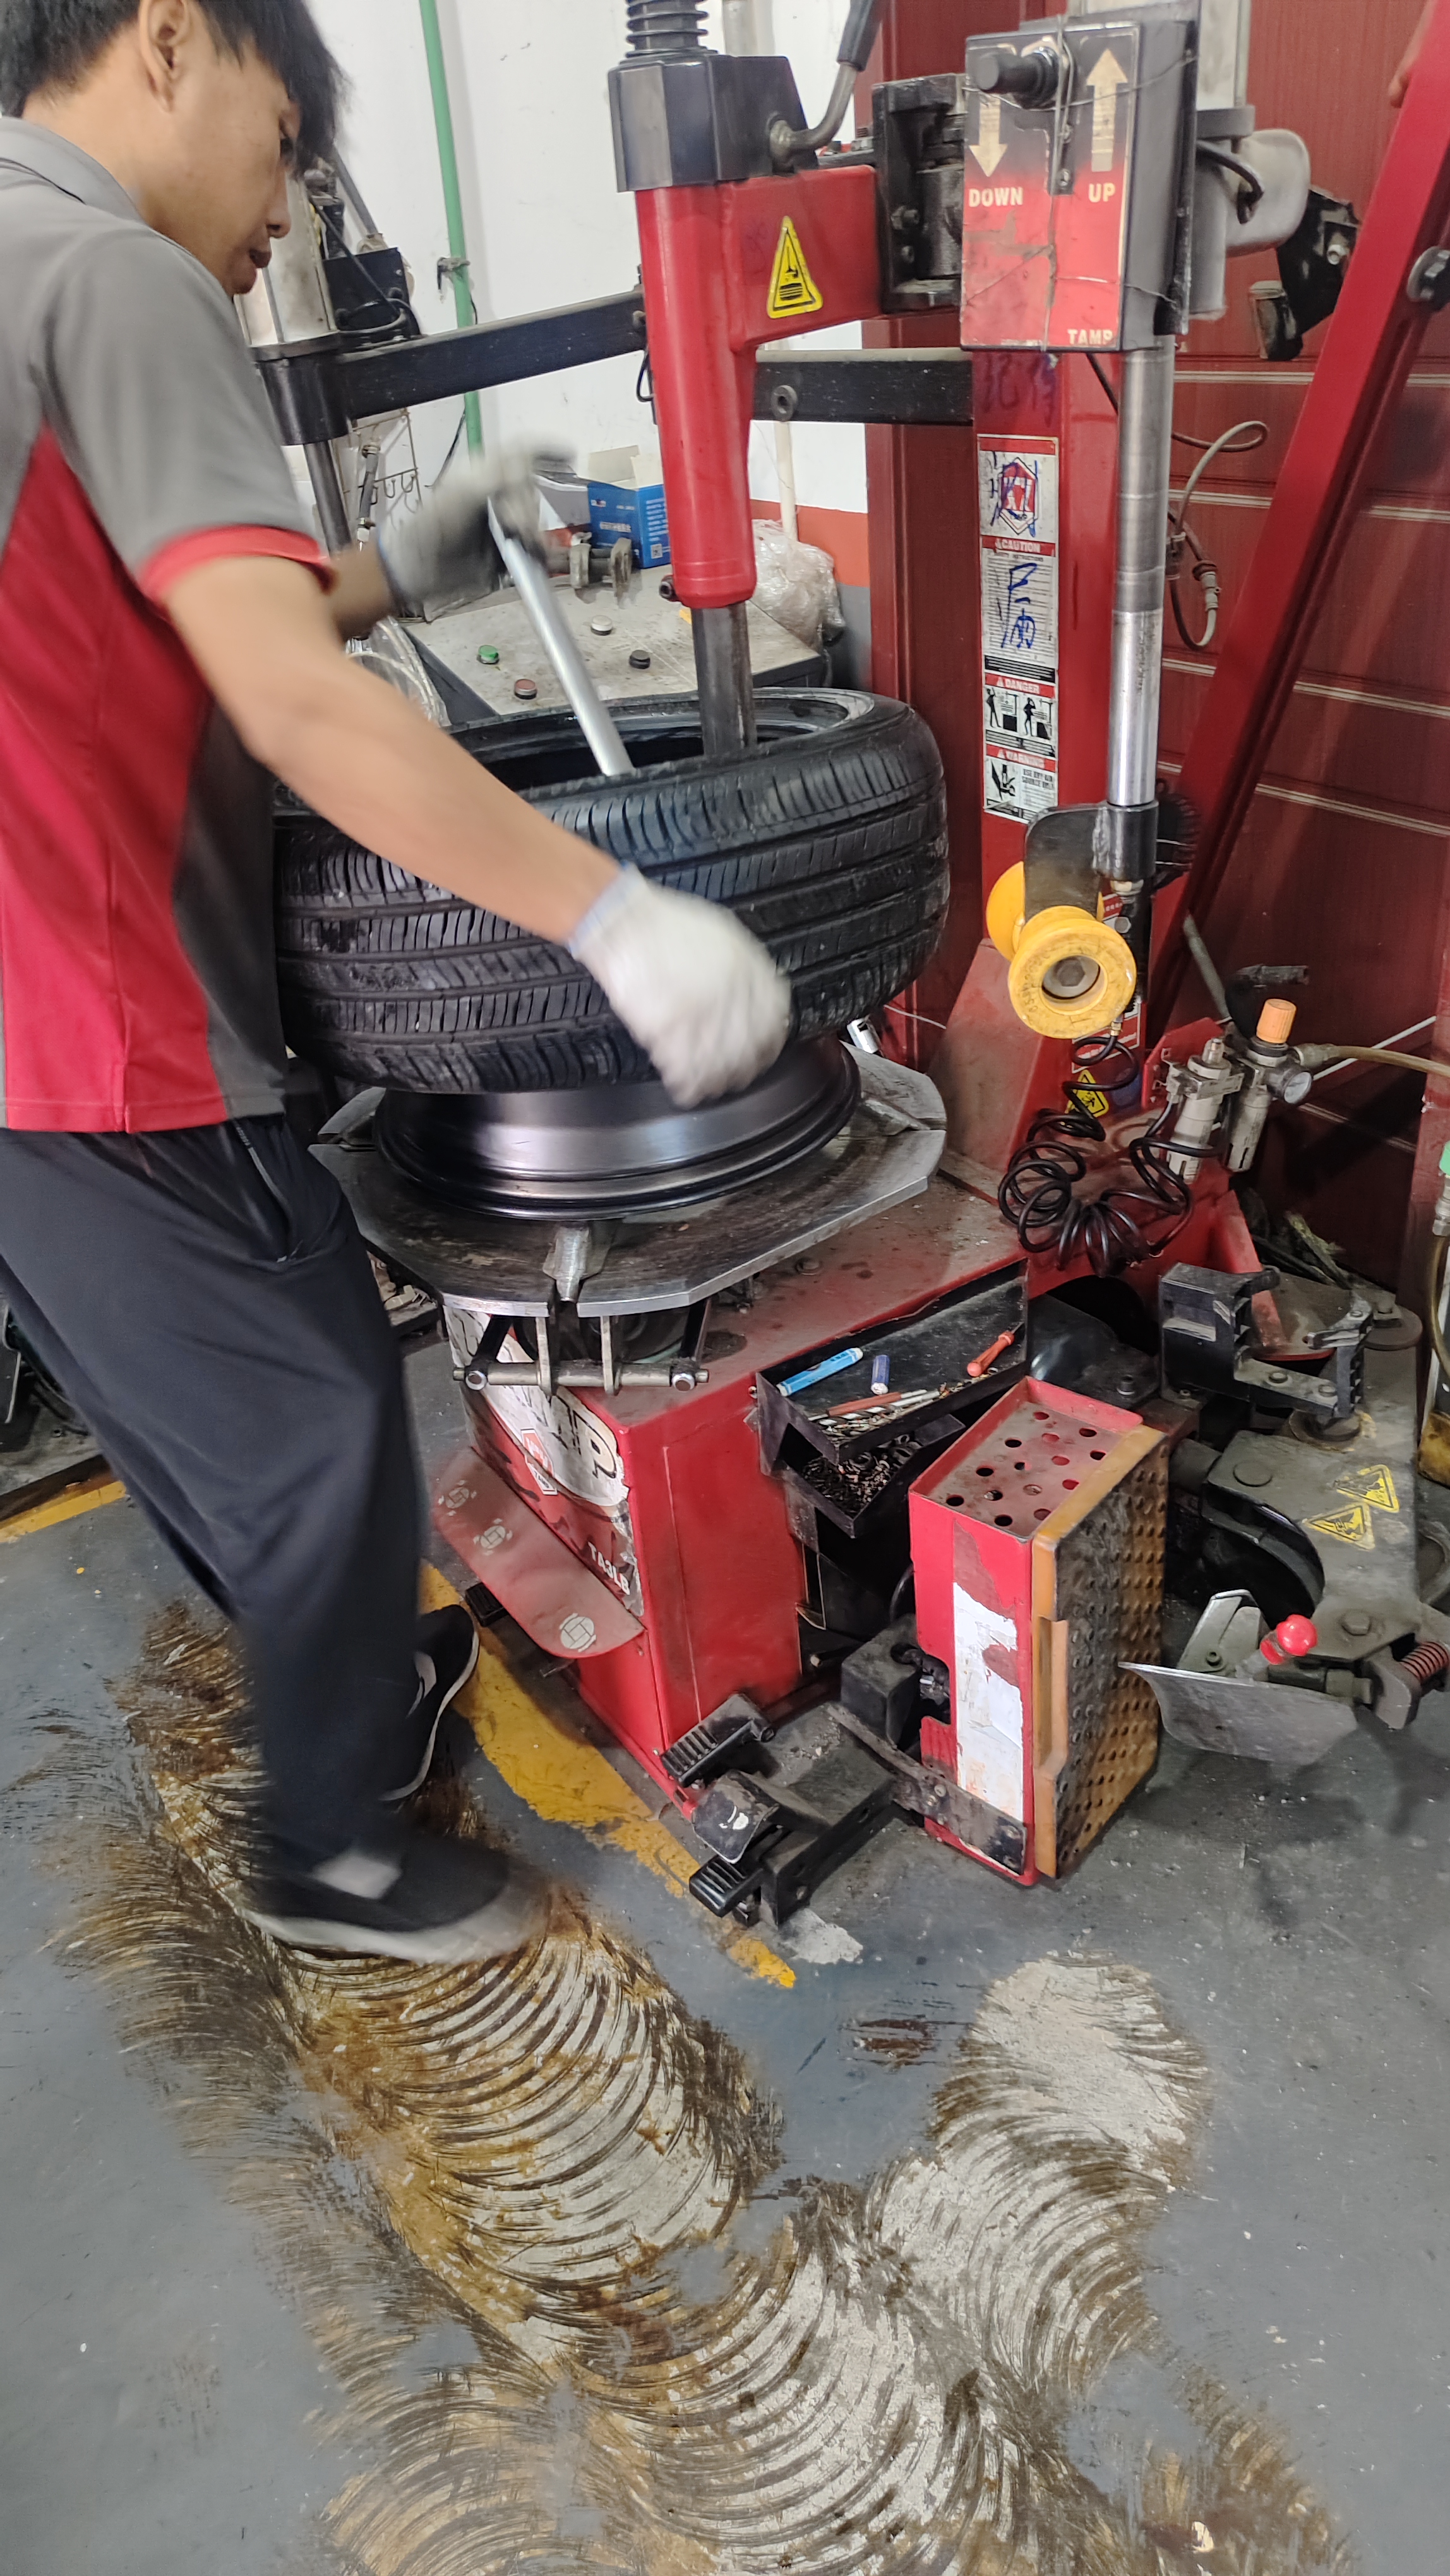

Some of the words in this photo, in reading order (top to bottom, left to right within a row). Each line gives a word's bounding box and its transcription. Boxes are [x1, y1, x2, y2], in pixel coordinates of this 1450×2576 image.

[968, 188, 1023, 207] DOWN
[1088, 183, 1116, 203] UP
[1067, 328, 1113, 346] TAMP
[1002, 539, 1041, 553] CAUTION
[1005, 678, 1040, 695] DANGER
[1006, 750, 1045, 769] WARNING
